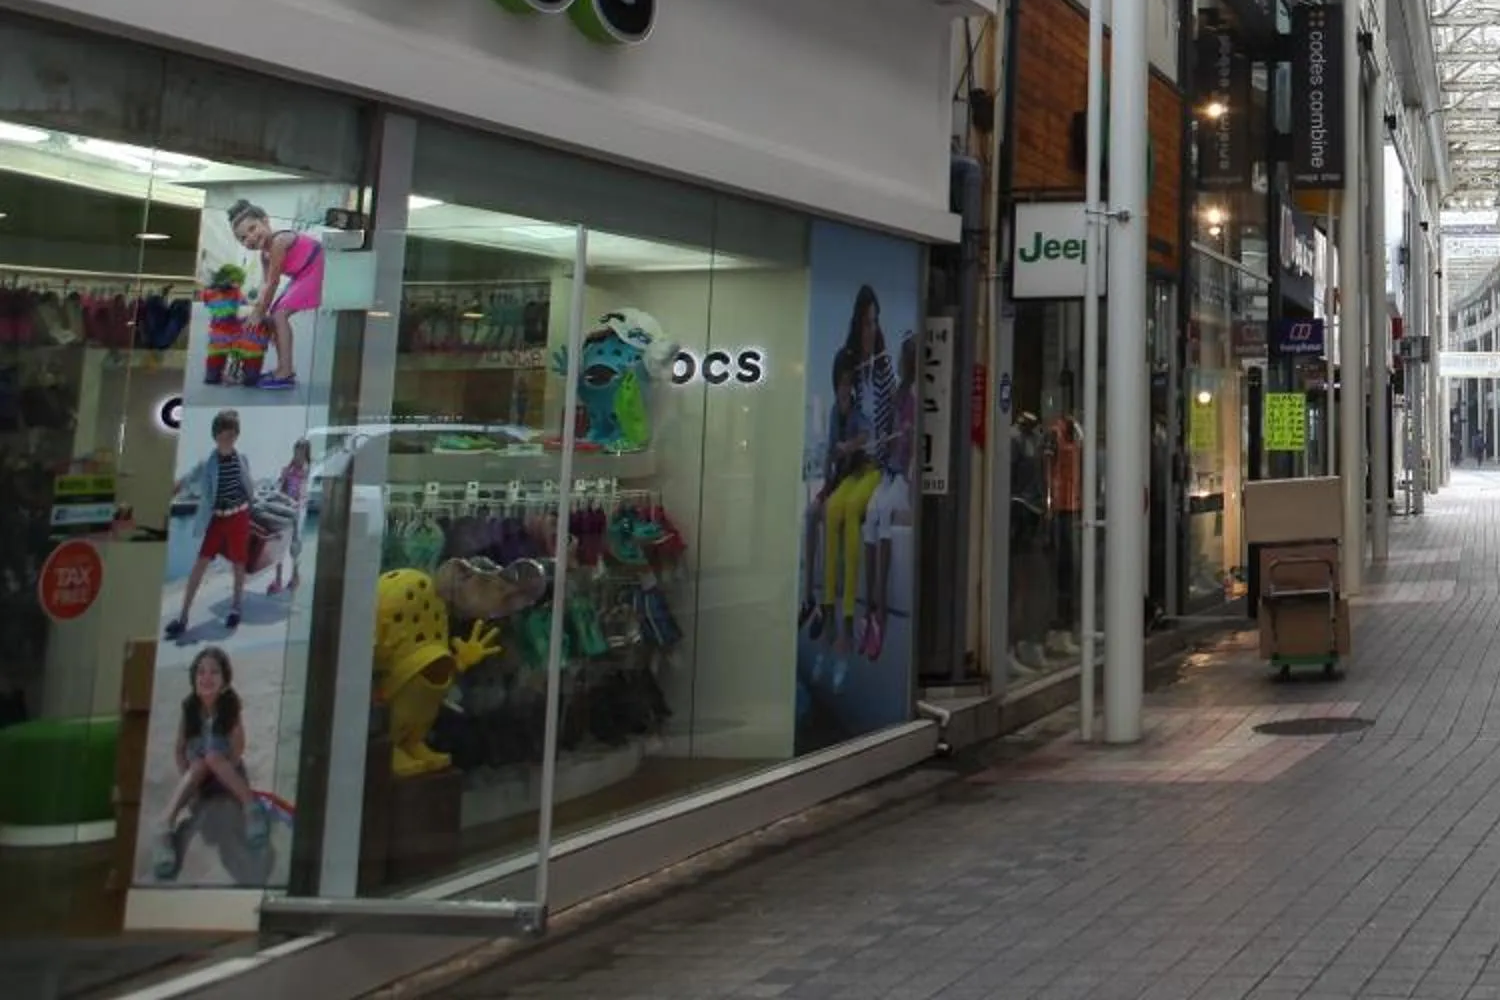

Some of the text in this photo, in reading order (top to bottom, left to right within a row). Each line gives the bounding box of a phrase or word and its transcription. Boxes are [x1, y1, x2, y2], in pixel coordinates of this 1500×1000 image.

[1308, 31, 1329, 169] codes combine
[1018, 231, 1086, 265] Jee
[671, 350, 761, 385] ocs
[54, 564, 94, 588] TAX
